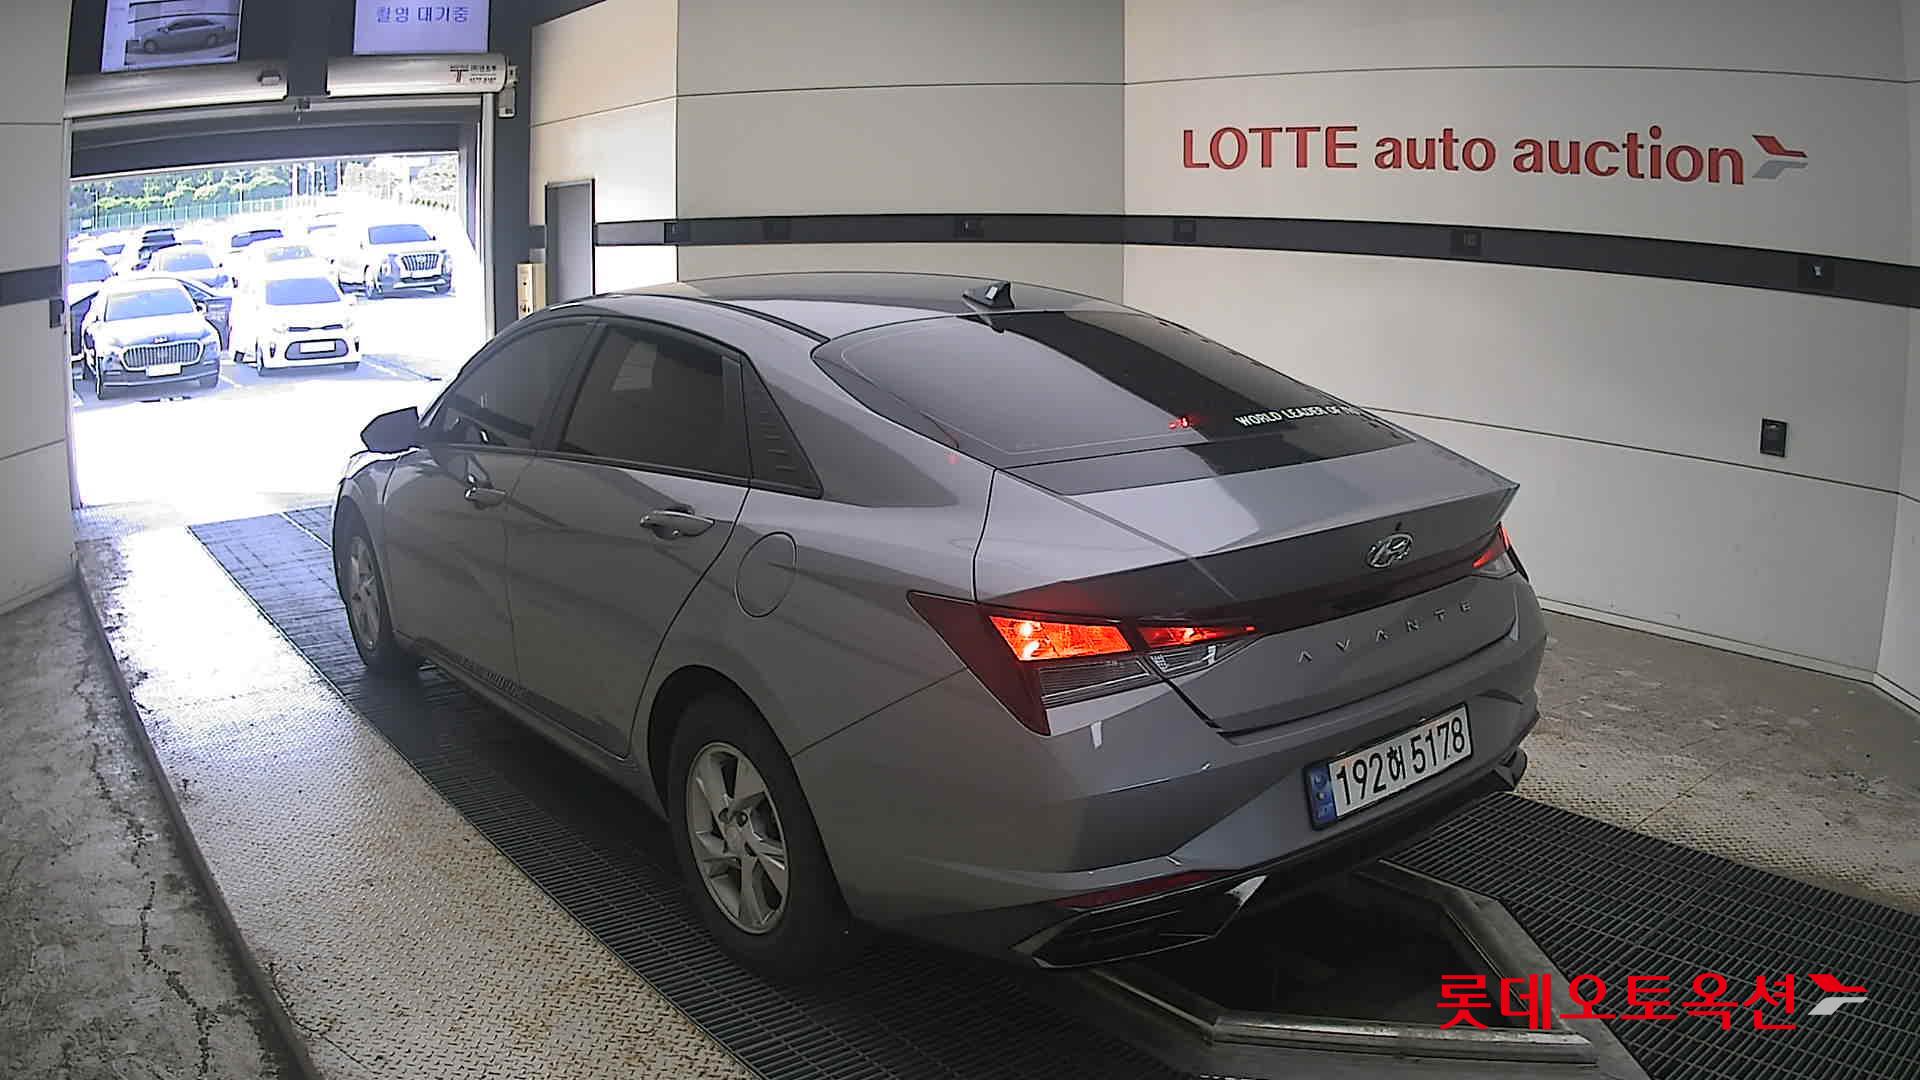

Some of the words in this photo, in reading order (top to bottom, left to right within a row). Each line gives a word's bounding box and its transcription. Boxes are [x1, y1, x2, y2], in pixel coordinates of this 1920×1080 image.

[417, 6, 469, 23] 대기중
[1184, 126, 1358, 170] LOTTE
[1375, 128, 1497, 172] auto
[1513, 126, 1745, 184] auction
[1235, 411, 1283, 426] WORLD
[1281, 406, 1329, 418] LEADER
[1298, 601, 1472, 664] AVANTE
[1336, 745, 1407, 806] 192허
[1409, 716, 1466, 775] 5178
